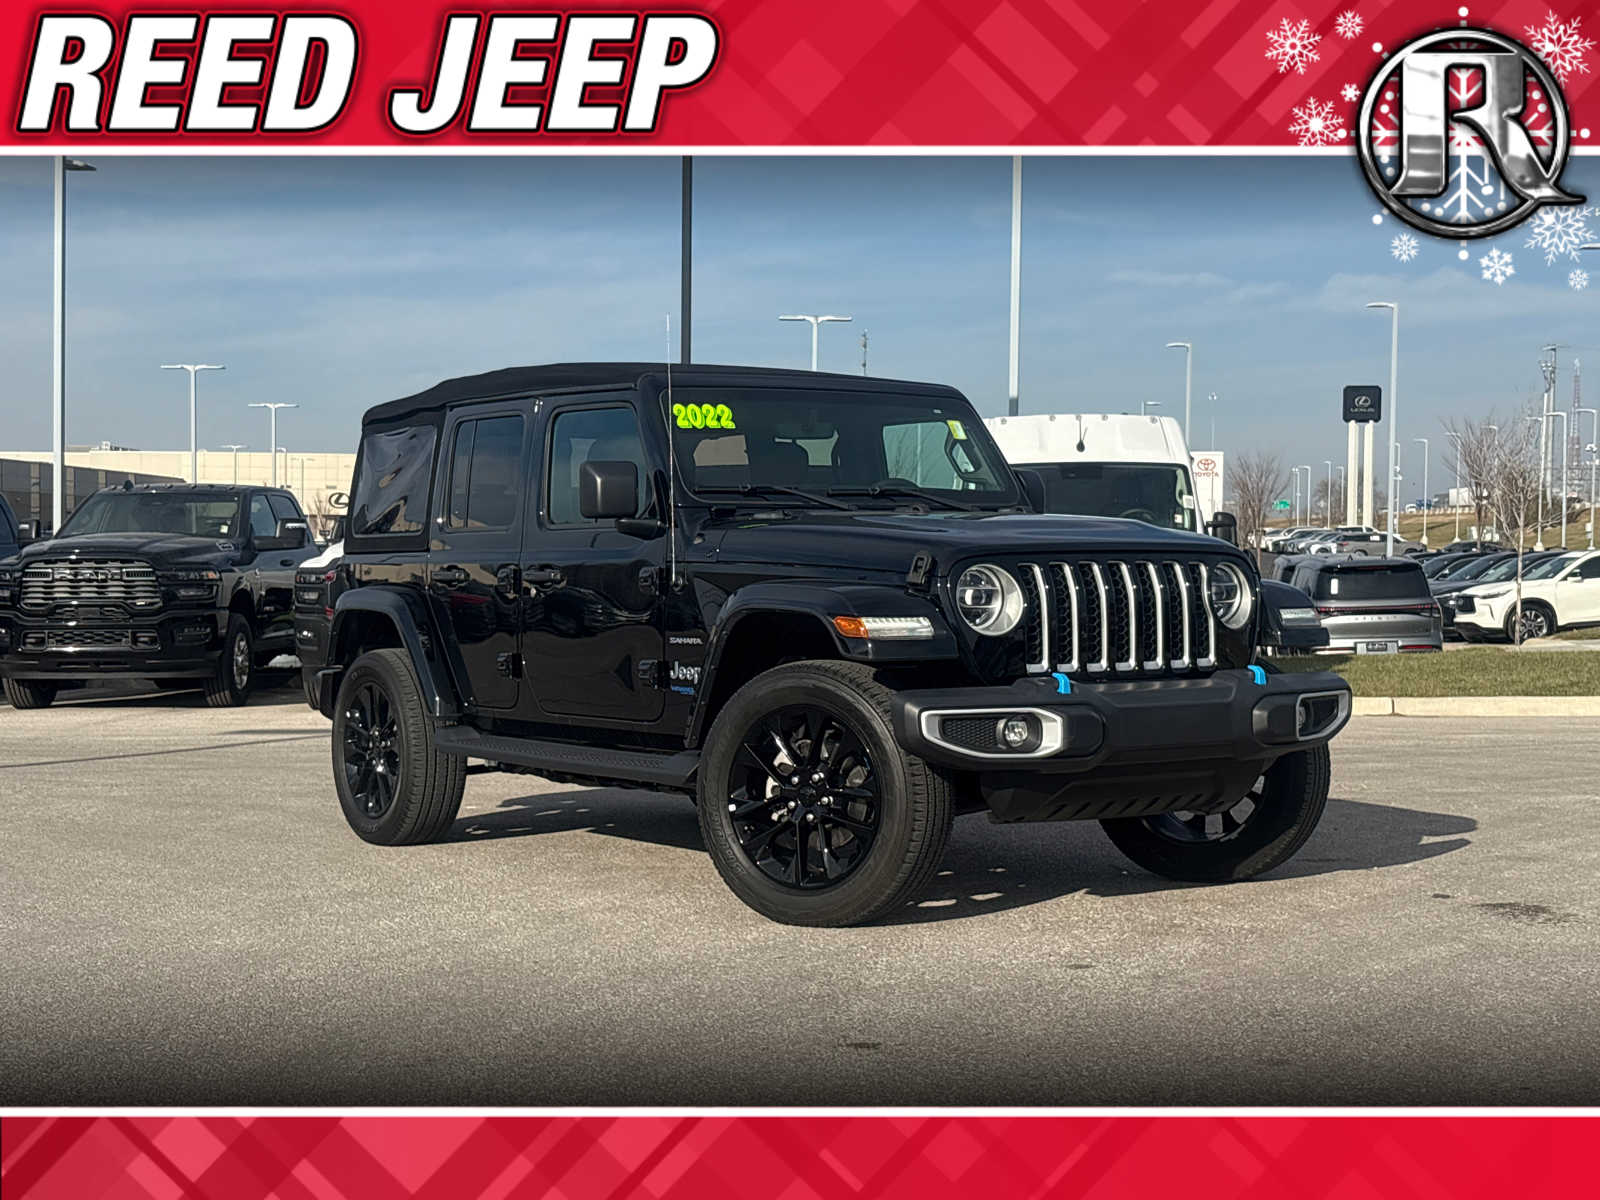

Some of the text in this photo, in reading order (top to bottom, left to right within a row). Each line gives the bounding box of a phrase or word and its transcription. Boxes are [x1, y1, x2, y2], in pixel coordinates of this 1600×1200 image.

[672, 403, 736, 429] 2022
[669, 636, 704, 645] SAHARA
[669, 660, 702, 685] Jeep
